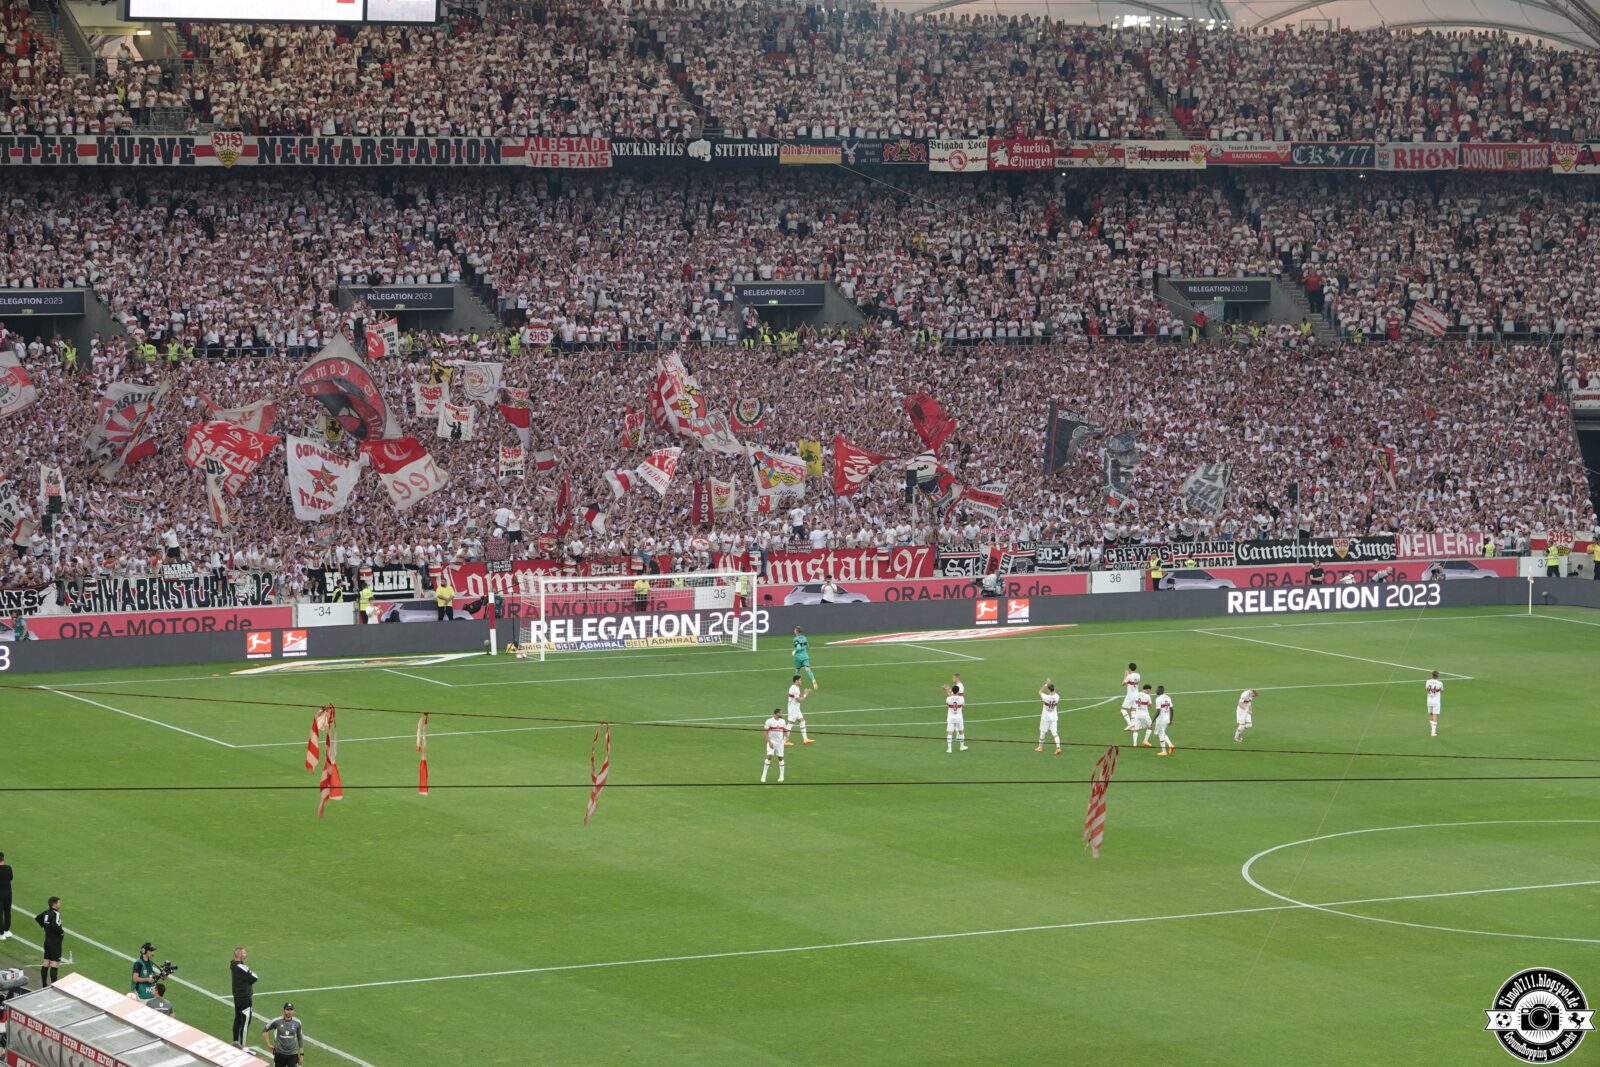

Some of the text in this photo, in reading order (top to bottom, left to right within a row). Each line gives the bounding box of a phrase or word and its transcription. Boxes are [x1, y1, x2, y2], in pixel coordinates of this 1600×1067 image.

[96, 137, 196, 166] KURVE
[257, 136, 501, 166] NECKARSTADION
[527, 137, 611, 151] ALBSTADT
[612, 142, 779, 156] NECKAR-FILS STUTTGART
[780, 144, 797, 156] Old
[801, 144, 841, 156] Warriors
[930, 140, 987, 151] Brigada Loca
[1013, 142, 1051, 154] Suebia
[530, 152, 609, 166] VFB-FANS
[1139, 146, 1190, 164] Hessen
[1348, 145, 1369, 165] 77
[1463, 147, 1549, 169] DONAU RIES
[1010, 157, 1053, 171] Ehingen
[414, 292, 432, 300] 2023
[1231, 285, 1248, 293] 2023
[700, 484, 709, 524] 1893
[1548, 531, 1573, 543] VfB
[1038, 547, 1066, 561] 50+1
[1237, 540, 1334, 561] Cannstatter
[1348, 538, 1396, 560] Jungs
[590, 563, 618, 576] SZENE
[892, 548, 930, 577] 97
[1174, 557, 1234, 568] STTTGART
[1109, 574, 1121, 584] 36
[250, 572, 272, 606] 02
[713, 588, 726, 599] 35
[885, 580, 1052, 602] ORA-MOR.de
[1228, 583, 1441, 614] RELEGATION 2023
[317, 606, 331, 617] 34
[59, 614, 252, 640] ORA-MOTOR.de
[530, 610, 769, 643] RELEGATION 2023
[580, 640, 624, 651] ADMIRAL
[651, 637, 696, 647] ADMIRAL
[10, 1009, 25, 1024] ELTEN
[27, 1018, 42, 1033] ELTEN
[44, 1026, 60, 1041] ELTEN
[62, 1034, 78, 1051] ELTEN
[79, 1043, 95, 1060] ELTEN
[96, 1051, 113, 1067] ELTEN
